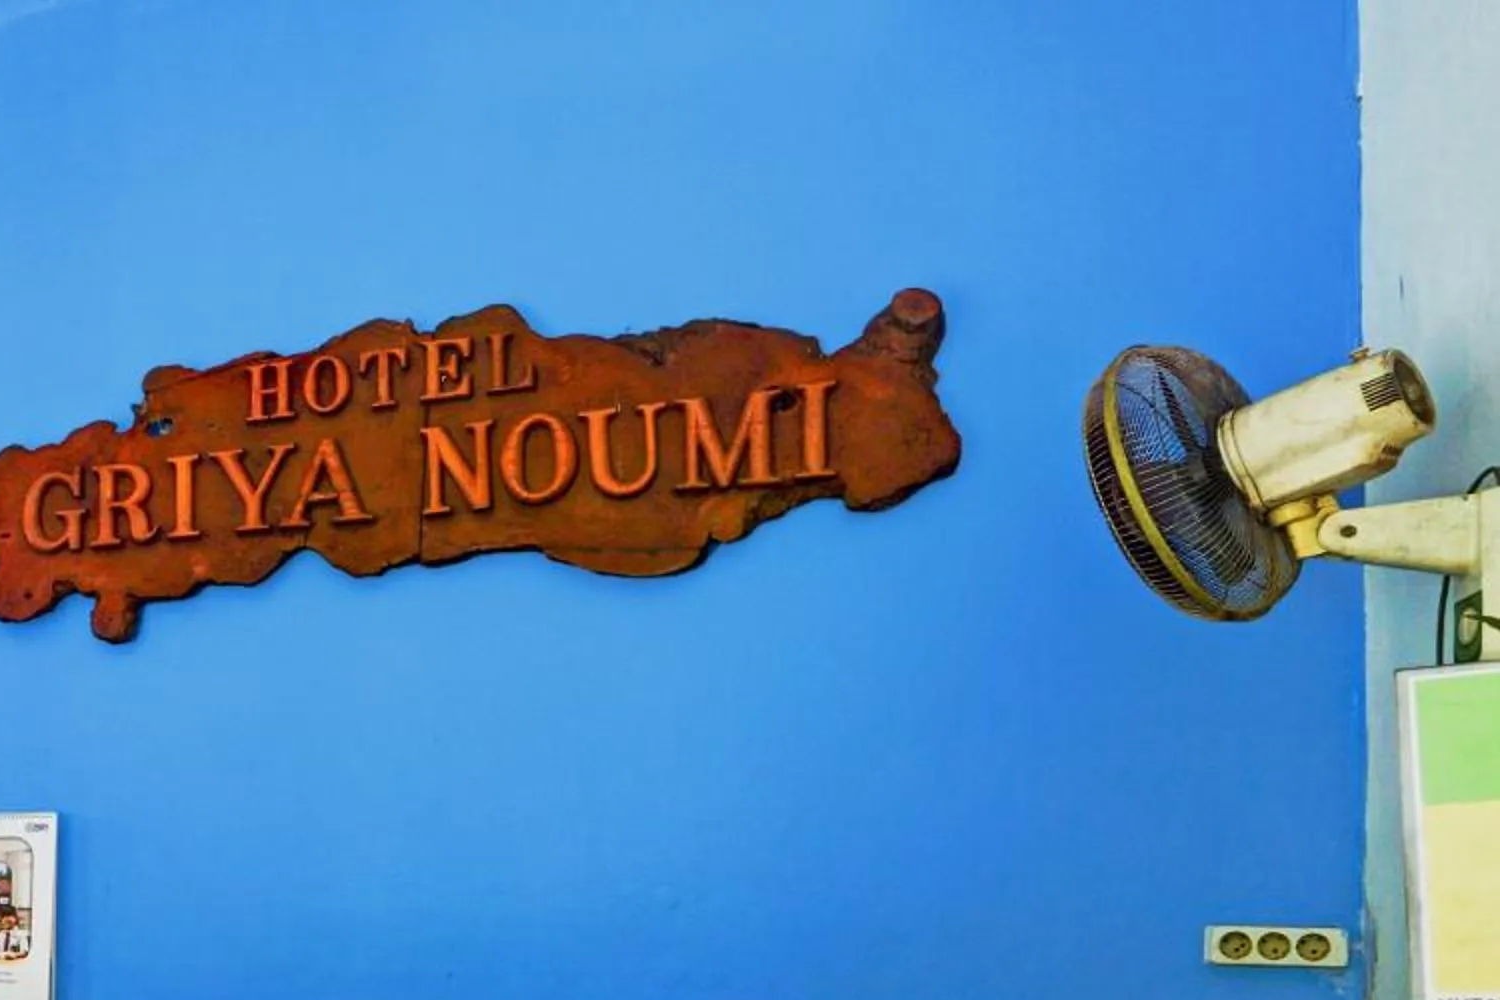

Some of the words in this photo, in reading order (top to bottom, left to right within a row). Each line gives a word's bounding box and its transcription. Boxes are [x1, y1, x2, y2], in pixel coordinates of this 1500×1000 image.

[245, 332, 537, 422] HOTEL
[22, 438, 374, 552] GRIYA
[419, 380, 839, 517] NOUMI
